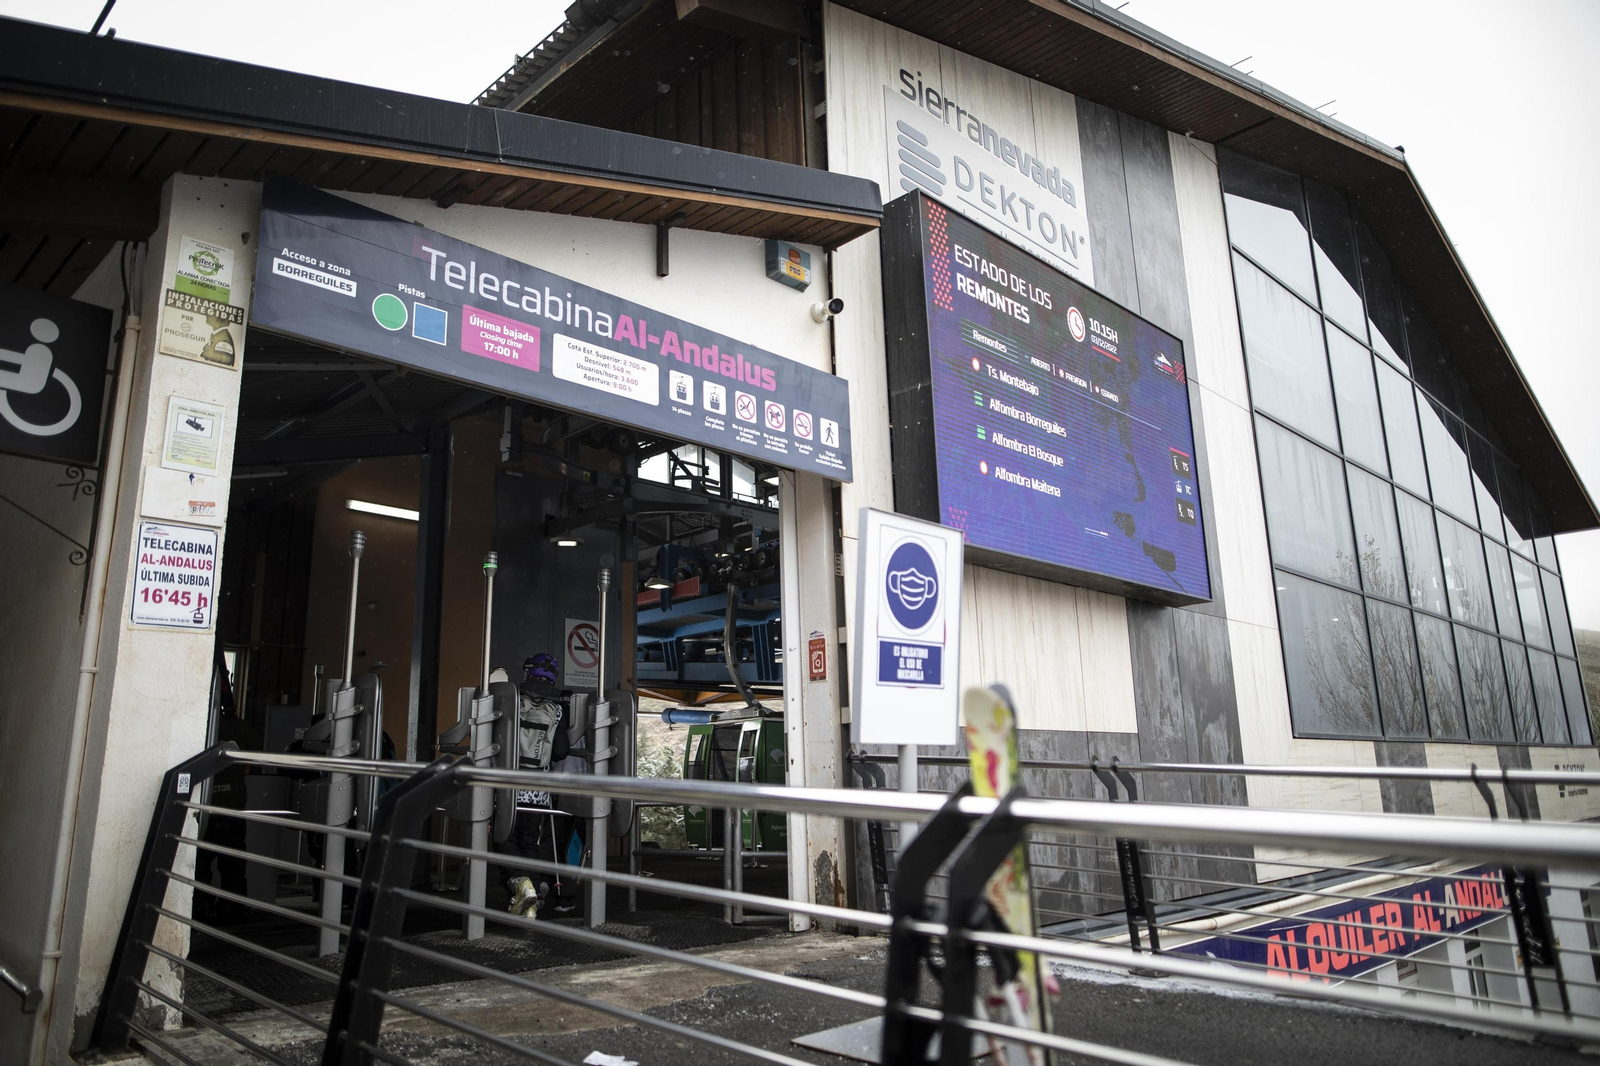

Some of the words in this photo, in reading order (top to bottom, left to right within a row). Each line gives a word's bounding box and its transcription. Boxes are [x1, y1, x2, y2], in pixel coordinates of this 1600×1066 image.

[281, 247, 317, 266] Acceso
[318, 260, 326, 268] a
[327, 262, 352, 276] zona
[178, 270, 200, 280] ALARMA
[200, 276, 230, 288] CONECTADA
[198, 281, 216, 291] HORAS
[277, 262, 353, 292] BORREGUILES
[954, 244, 1008, 287] ESTADO
[1010, 274, 1027, 298] DE
[1028, 283, 1052, 310] LOS
[398, 283, 426, 299] Pistas
[956, 272, 1030, 324] REMONTES
[166, 299, 242, 324] PROTEGIDAS
[167, 290, 243, 316] INSTALACIONES
[182, 314, 194, 322] POR
[164, 328, 206, 343] PROSEGUR
[469, 314, 502, 333] Última
[503, 325, 534, 343] bajada
[1088, 318, 1118, 344] 10.15H
[480, 330, 506, 346] Closing
[506, 338, 523, 350] time
[972, 330, 1008, 353] Remontes
[484, 342, 511, 357] 17:00
[512, 350, 519, 360] h
[568, 342, 582, 352] Cota
[582, 347, 594, 356] Est.
[595, 350, 622, 364] Superior:
[623, 360, 640, 370] 2.700
[576, 362, 620, 380] Usuarios/hora:
[621, 376, 638, 386] 3.600
[584, 356, 612, 370] Desnivel:
[612, 364, 624, 374] 548
[583, 373, 612, 386] Apertura:
[986, 364, 999, 380] Ts.
[1000, 370, 1040, 396] Montebajo
[678, 408, 692, 416] plazas
[990, 398, 1026, 422] Alfombra
[1026, 412, 1067, 438] Borreguiles
[712, 422, 724, 431] plazas
[992, 432, 1028, 454] Alfombra
[1028, 444, 1036, 458] El
[1036, 448, 1064, 467] Bosque
[1182, 461, 1189, 472] TS
[994, 466, 1031, 488] Alfombra
[1032, 478, 1061, 498] Maitena
[1184, 484, 1192, 495] TC
[142, 536, 212, 556] TELECABINA
[140, 552, 212, 571] AL-ANDALUS
[140, 568, 175, 584] ÚLTIMA
[178, 573, 210, 587] SUBIDA
[140, 587, 192, 606] 16'45
[197, 592, 208, 608] h
[893, 645, 900, 657] ES
[900, 646, 928, 660] OBLIGATORIO
[899, 656, 906, 668] EL
[906, 658, 916, 669] USO
[916, 658, 922, 670] DE
[897, 668, 924, 681] MASCARILLA
[534, 730, 544, 759] BURTON
[1267, 902, 1406, 985] ALQUILER
